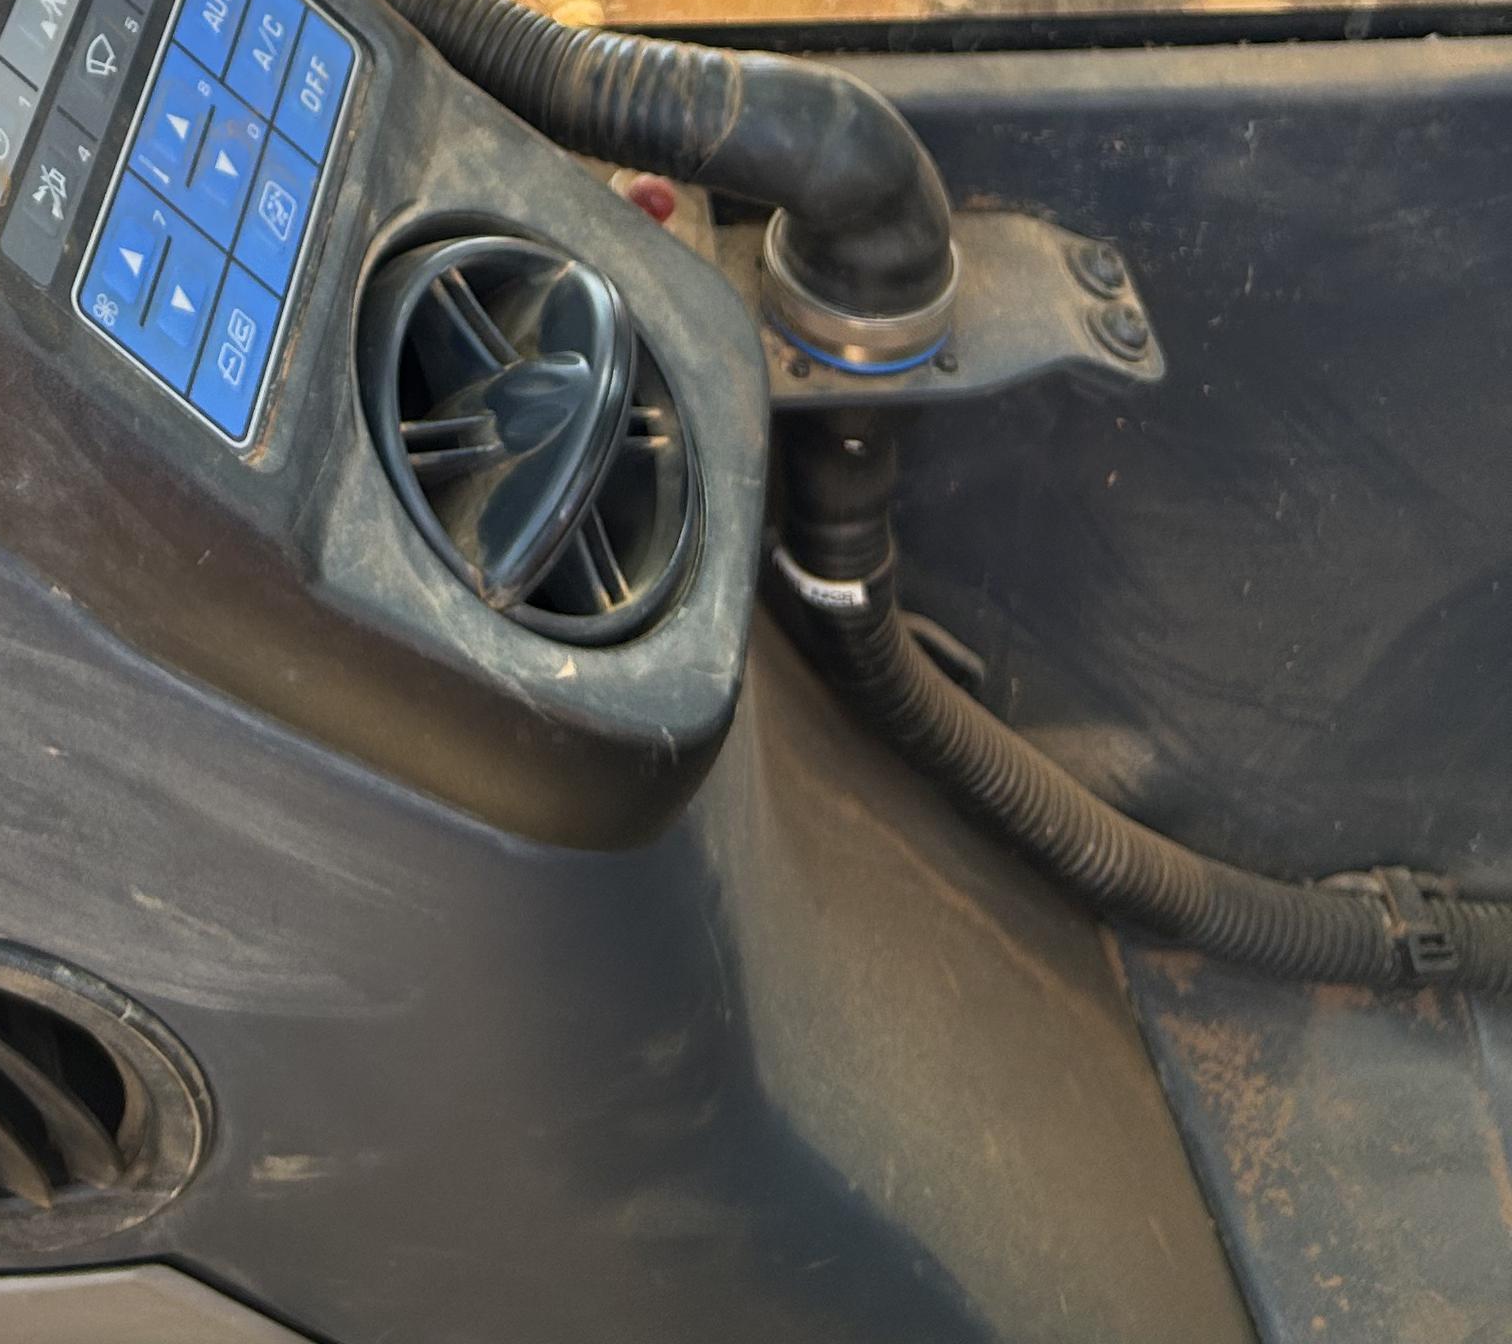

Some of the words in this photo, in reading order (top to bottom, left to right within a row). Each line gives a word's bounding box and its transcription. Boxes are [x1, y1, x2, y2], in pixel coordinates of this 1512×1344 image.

[124, 16, 139, 33] 5
[252, 14, 284, 72] A/C
[197, 79, 211, 97] 8
[300, 55, 330, 113] OFF
[18, 95, 32, 108] 1
[77, 144, 92, 162] 4
[152, 209, 166, 226] 7
